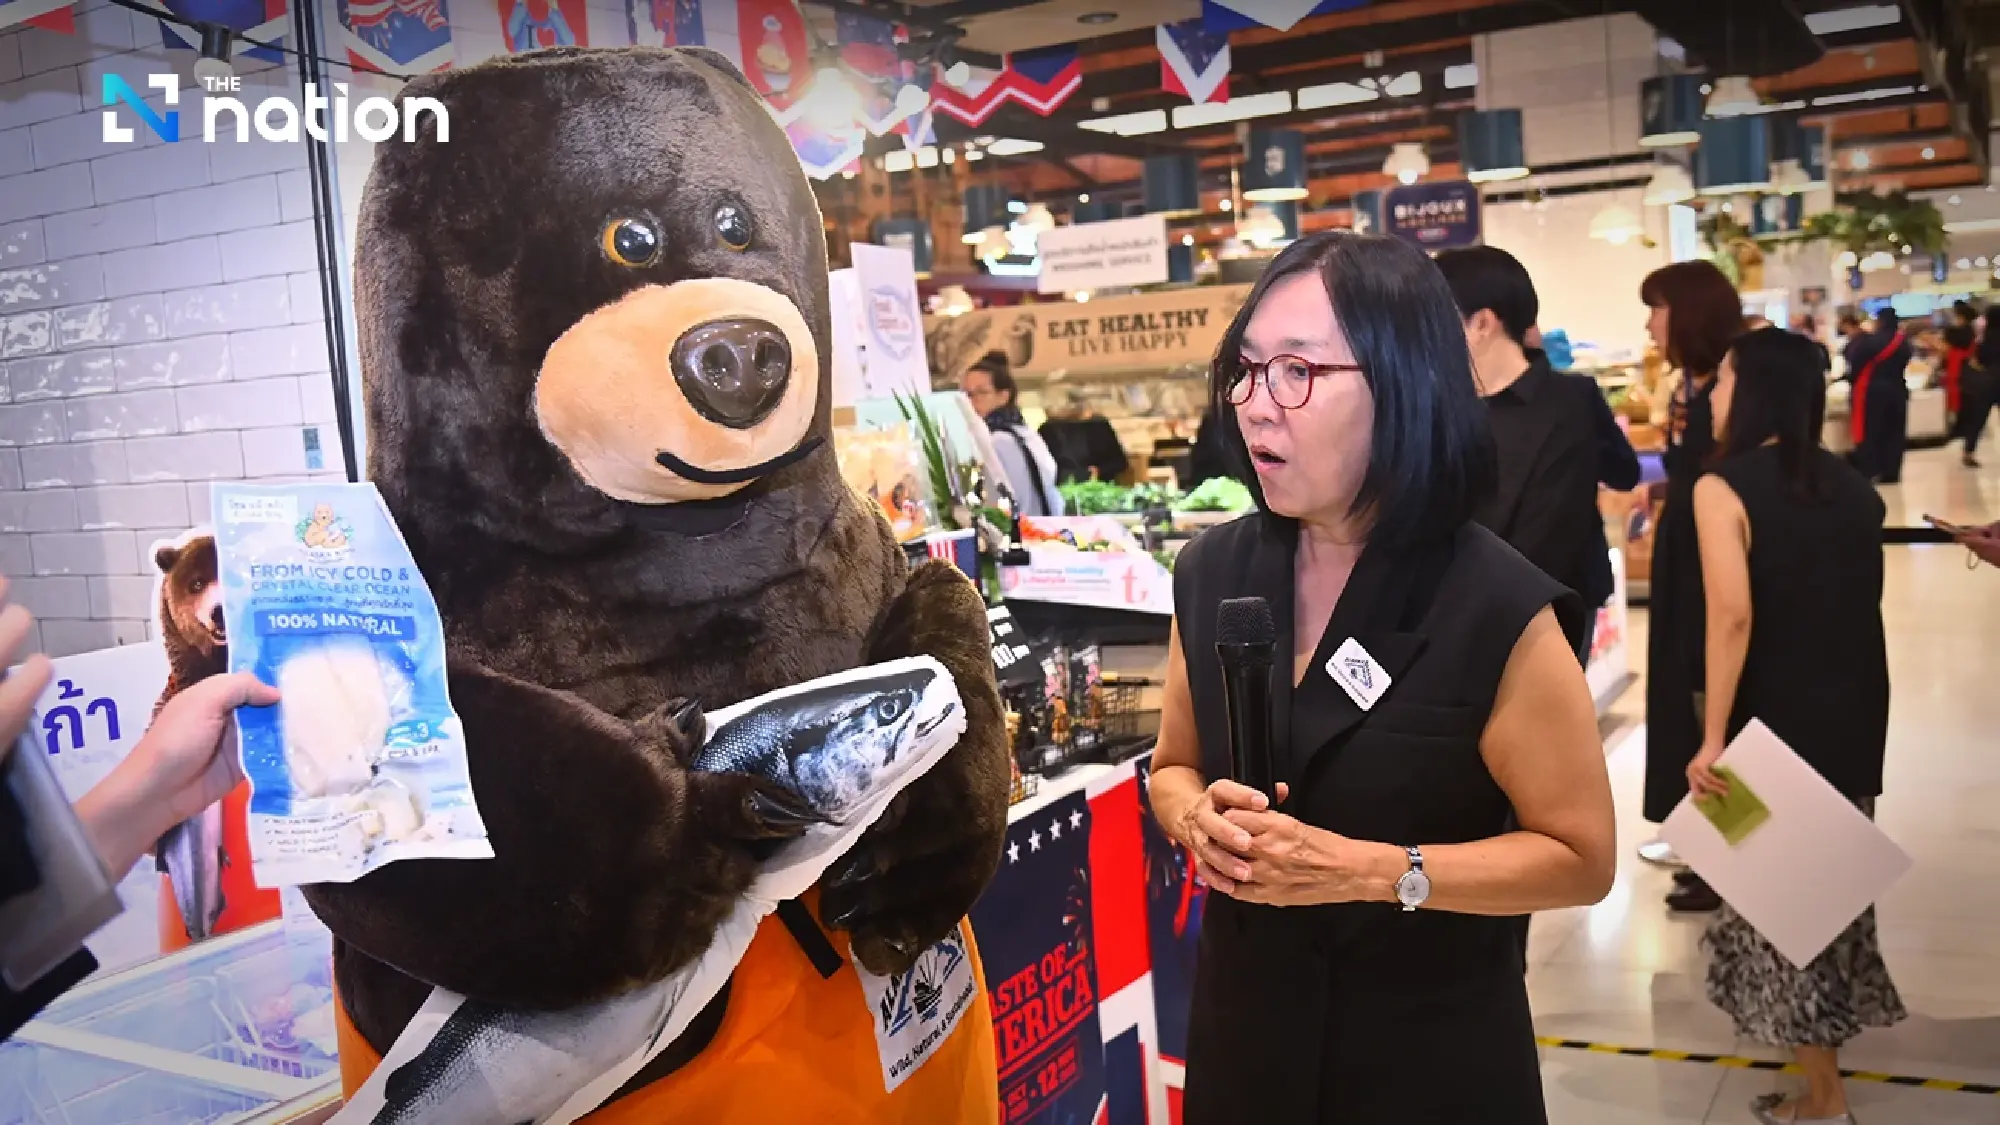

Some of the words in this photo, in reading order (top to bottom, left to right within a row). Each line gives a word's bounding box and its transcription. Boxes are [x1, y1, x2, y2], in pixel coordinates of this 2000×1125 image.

[1047, 319, 1090, 339] EAT
[1099, 308, 1209, 334] HEALTHY
[1068, 337, 1110, 356] LIVE
[1119, 331, 1191, 352] HAPPY
[251, 564, 304, 579] FROM
[309, 566, 337, 580] ICY
[343, 566, 392, 581] COLD
[398, 568, 409, 581] &
[316, 581, 359, 594] CLEAR
[365, 583, 410, 596] OCEAN
[268, 613, 318, 629] 100%
[321, 613, 402, 635] NATURAL
[988, 962, 1039, 1018] ASTE
[1041, 942, 1068, 984] OF
[993, 963, 1094, 1069] ERICA
[888, 1053, 913, 1078] Wild,
